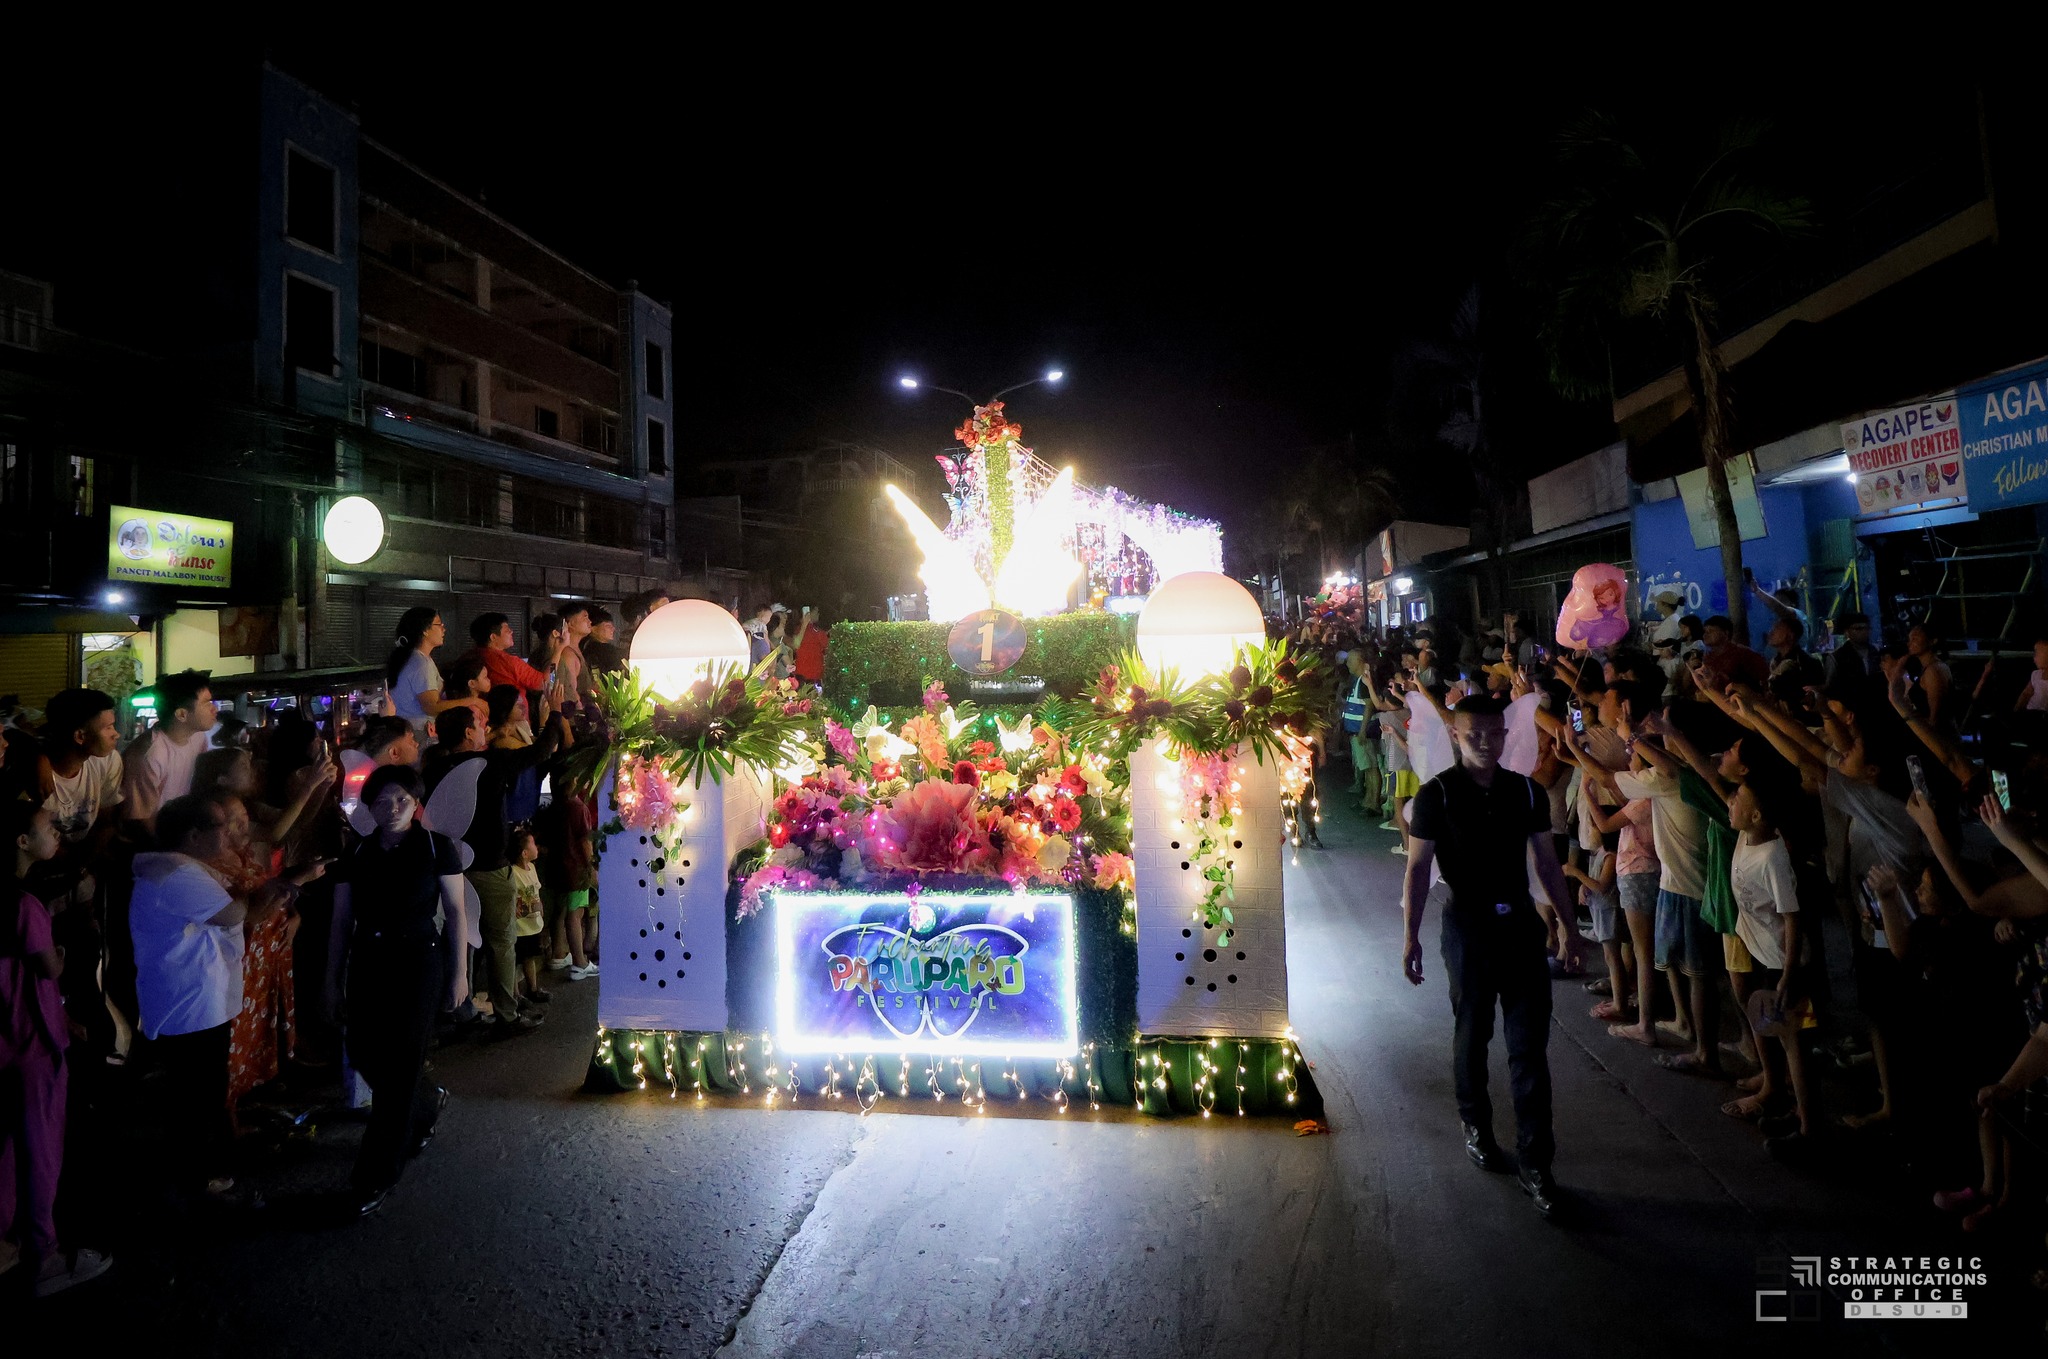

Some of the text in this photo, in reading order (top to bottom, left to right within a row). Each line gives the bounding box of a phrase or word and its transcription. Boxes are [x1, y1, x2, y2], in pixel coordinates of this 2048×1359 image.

[1984, 378, 2048, 427] AGA
[1862, 404, 1934, 448] AGAPE
[1963, 429, 2032, 460] CHRISTIAN
[1850, 428, 1960, 472] RECOVERY CENTER
[116, 566, 227, 583] PANCIT MALABON HOUSE
[977, 622, 995, 662] 1
[826, 954, 1027, 996] PARUPARO
[857, 995, 998, 1010] FESTIVAL
